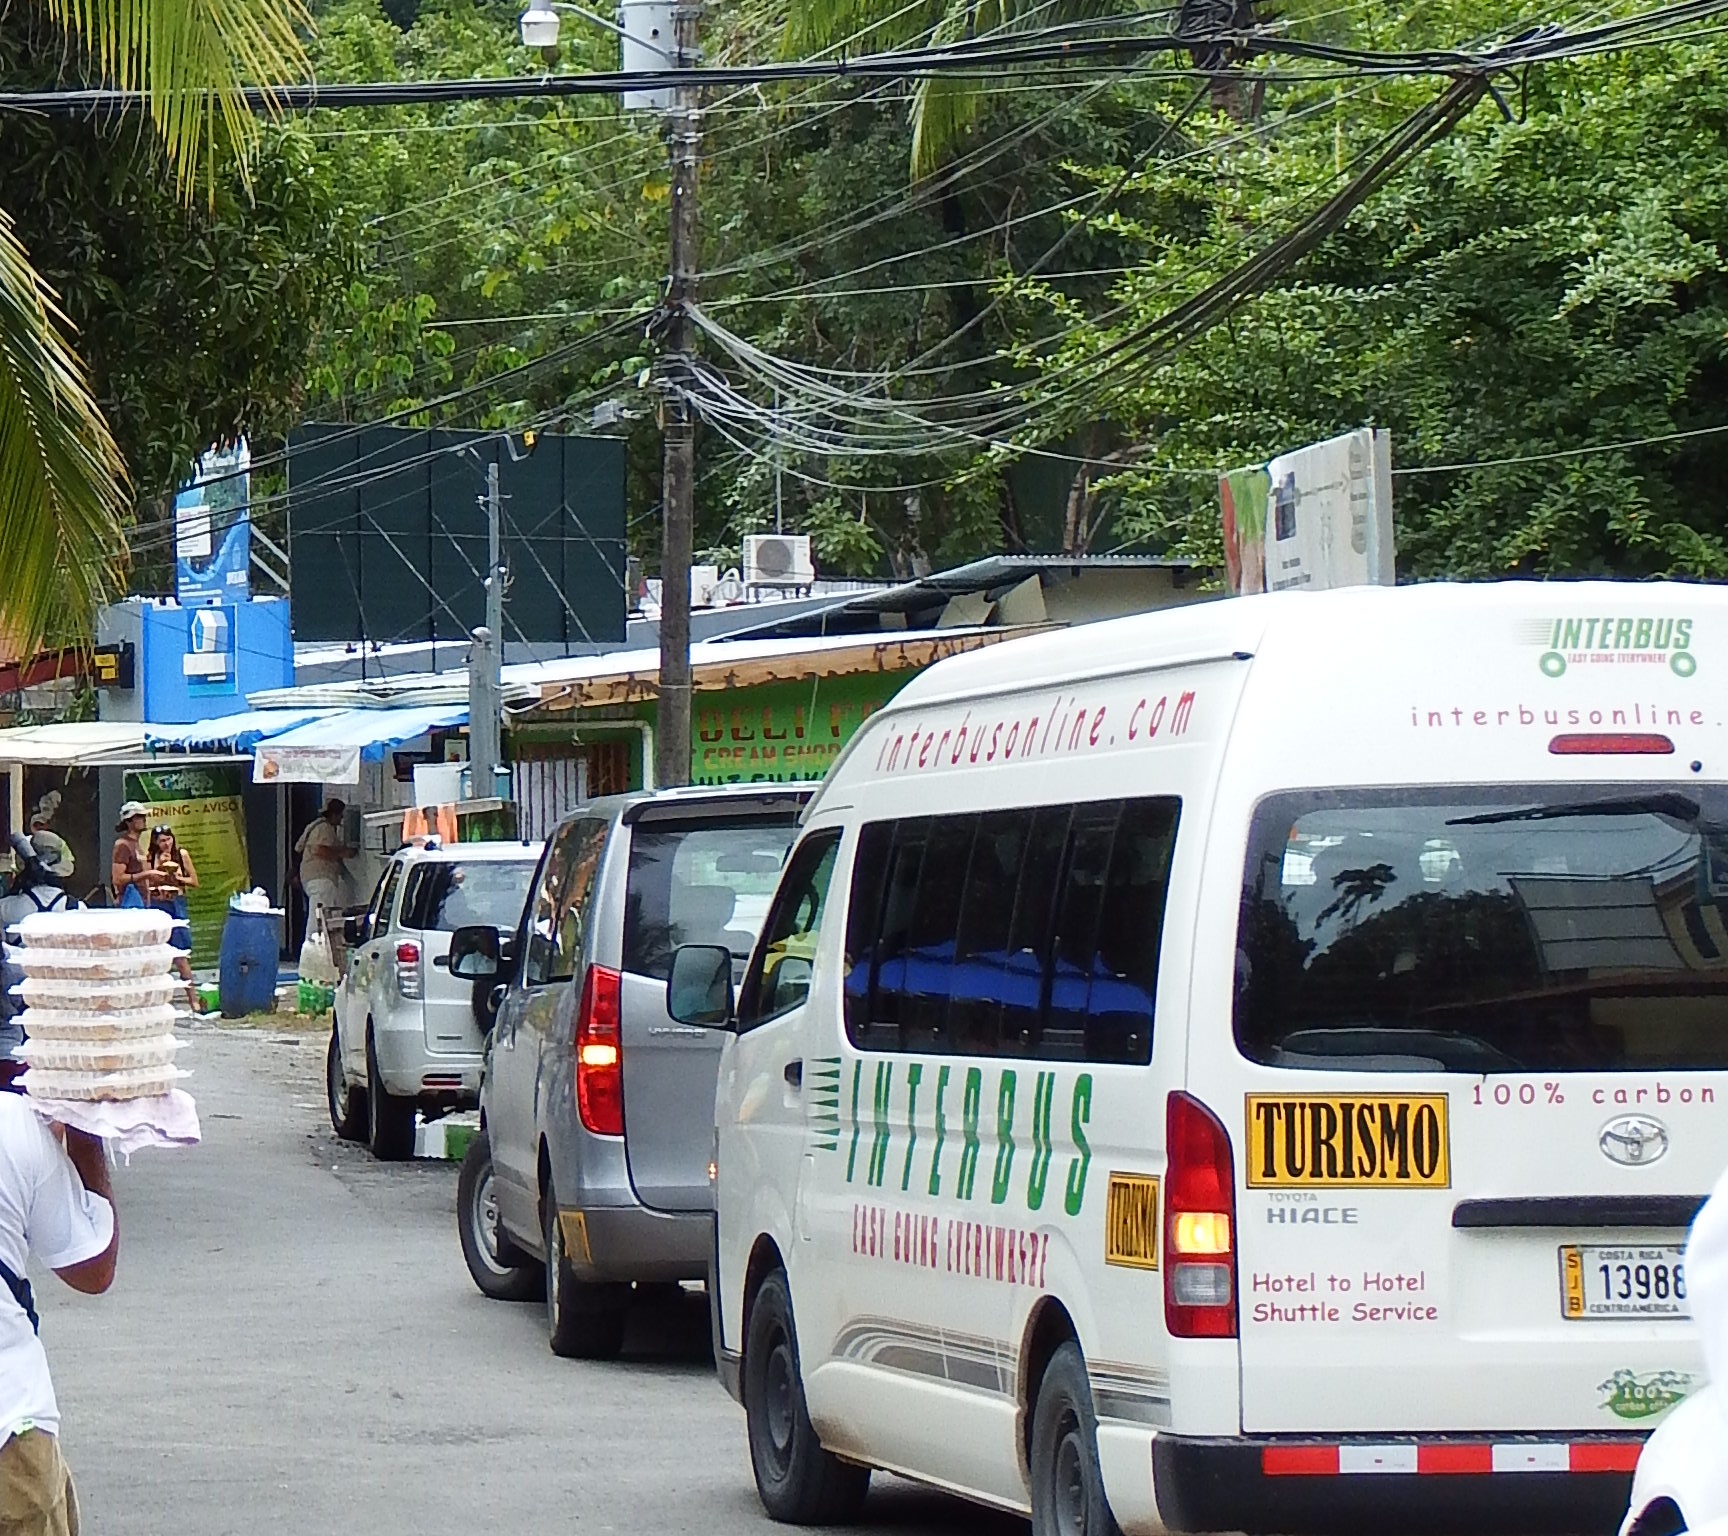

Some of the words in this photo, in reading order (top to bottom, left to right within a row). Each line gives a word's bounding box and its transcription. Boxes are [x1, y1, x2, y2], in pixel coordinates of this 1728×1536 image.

[1550, 617, 1693, 650] INTERBUS
[1567, 653, 1589, 664] EASY
[1590, 653, 1615, 664] GOING
[1617, 653, 1667, 664] EVERYWHERE
[875, 690, 1196, 773] interbusonline.com
[703, 746, 778, 770] CREAM
[202, 799, 239, 815] AVISO
[1472, 1081, 1565, 1106] 100%
[1592, 1081, 1715, 1105] carbon
[846, 1058, 1093, 1216] INTERBUS
[1256, 1101, 1440, 1180] TURISMO
[1268, 1192, 1318, 1202] TOYOTA
[1267, 1207, 1359, 1224] HIACE
[1598, 1250, 1634, 1261] COSTA
[1638, 1250, 1664, 1261] RICA
[1252, 1272, 1316, 1292] Hotel
[1327, 1274, 1352, 1292] to
[1363, 1270, 1425, 1292] Hotel
[1252, 1301, 1340, 1322] Shuttle
[1351, 1301, 1439, 1322] Service
[1589, 1303, 1680, 1314] CENTROAMERICA
